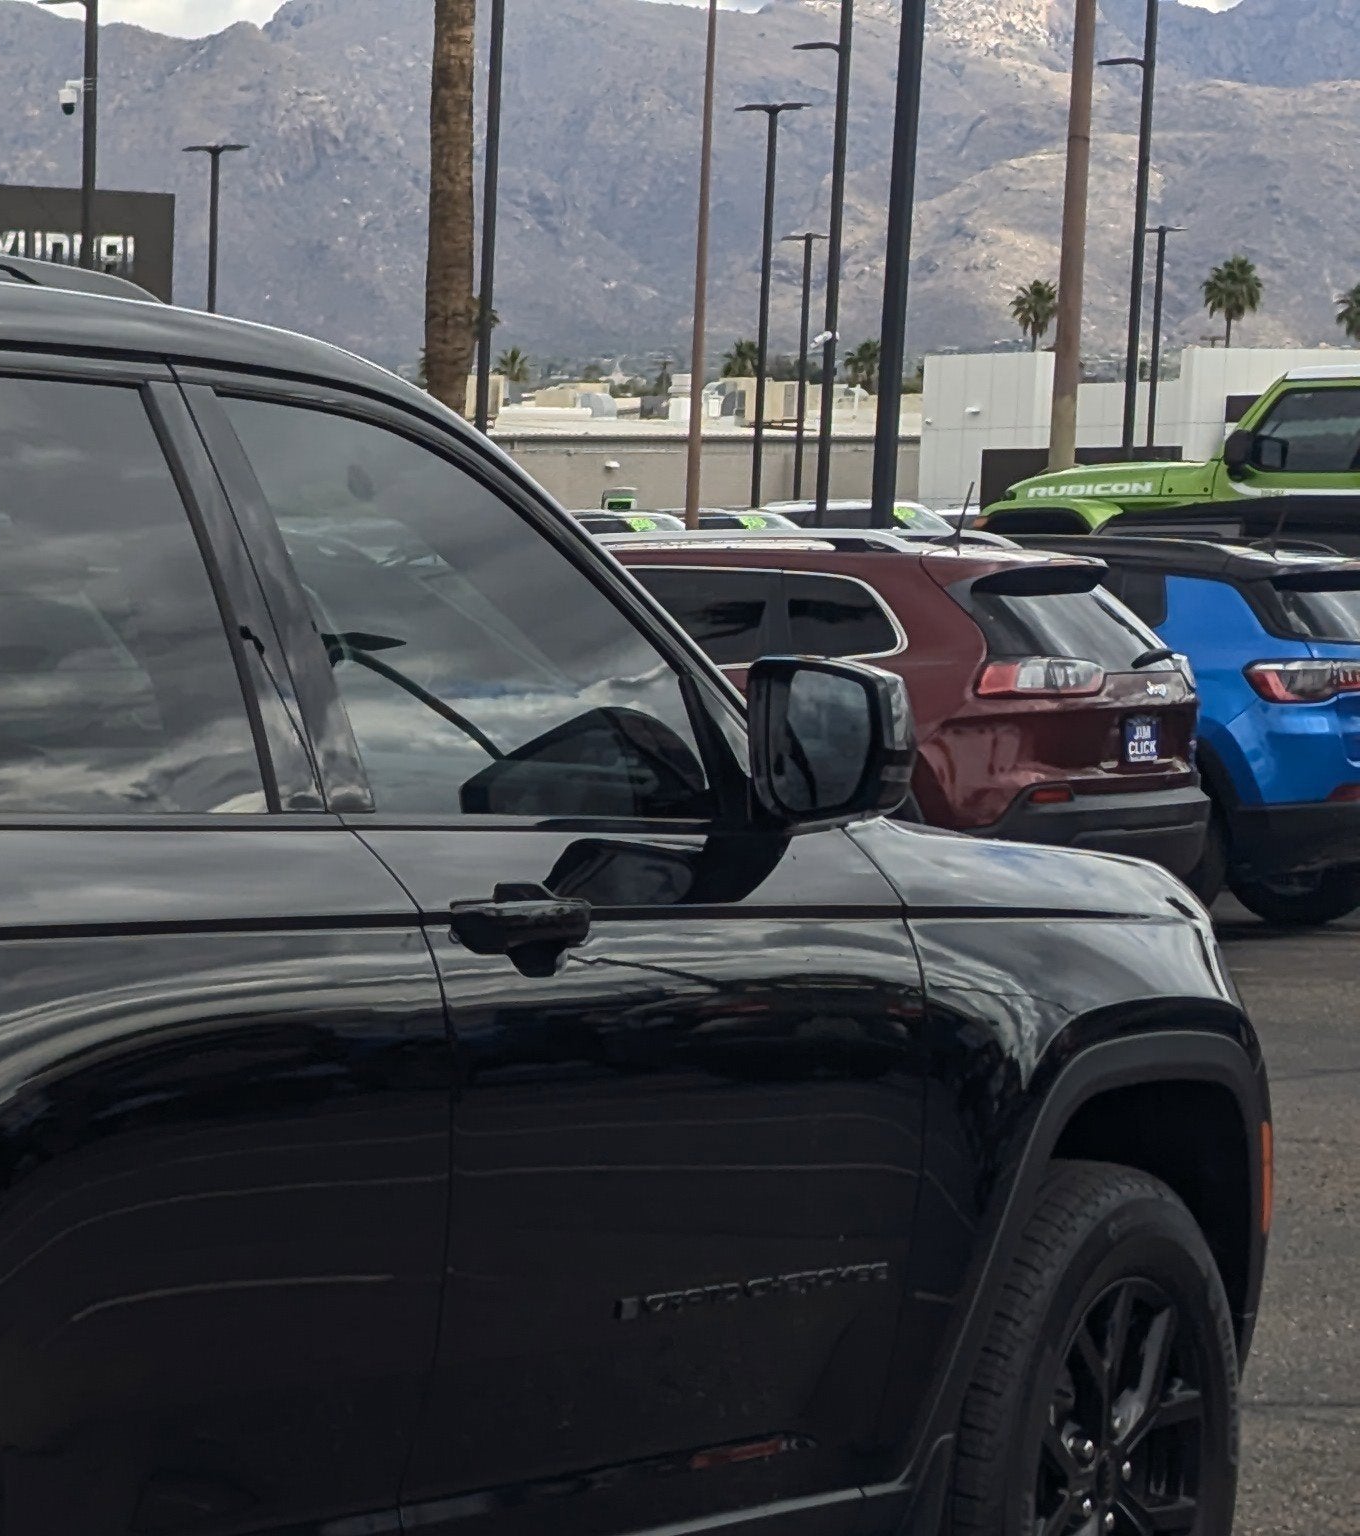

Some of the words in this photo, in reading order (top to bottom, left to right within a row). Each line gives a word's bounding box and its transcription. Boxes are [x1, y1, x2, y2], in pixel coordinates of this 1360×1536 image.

[1027, 481, 1153, 498] RUBICON
[1133, 725, 1152, 740] JIM
[1128, 740, 1157, 755] CLICK
